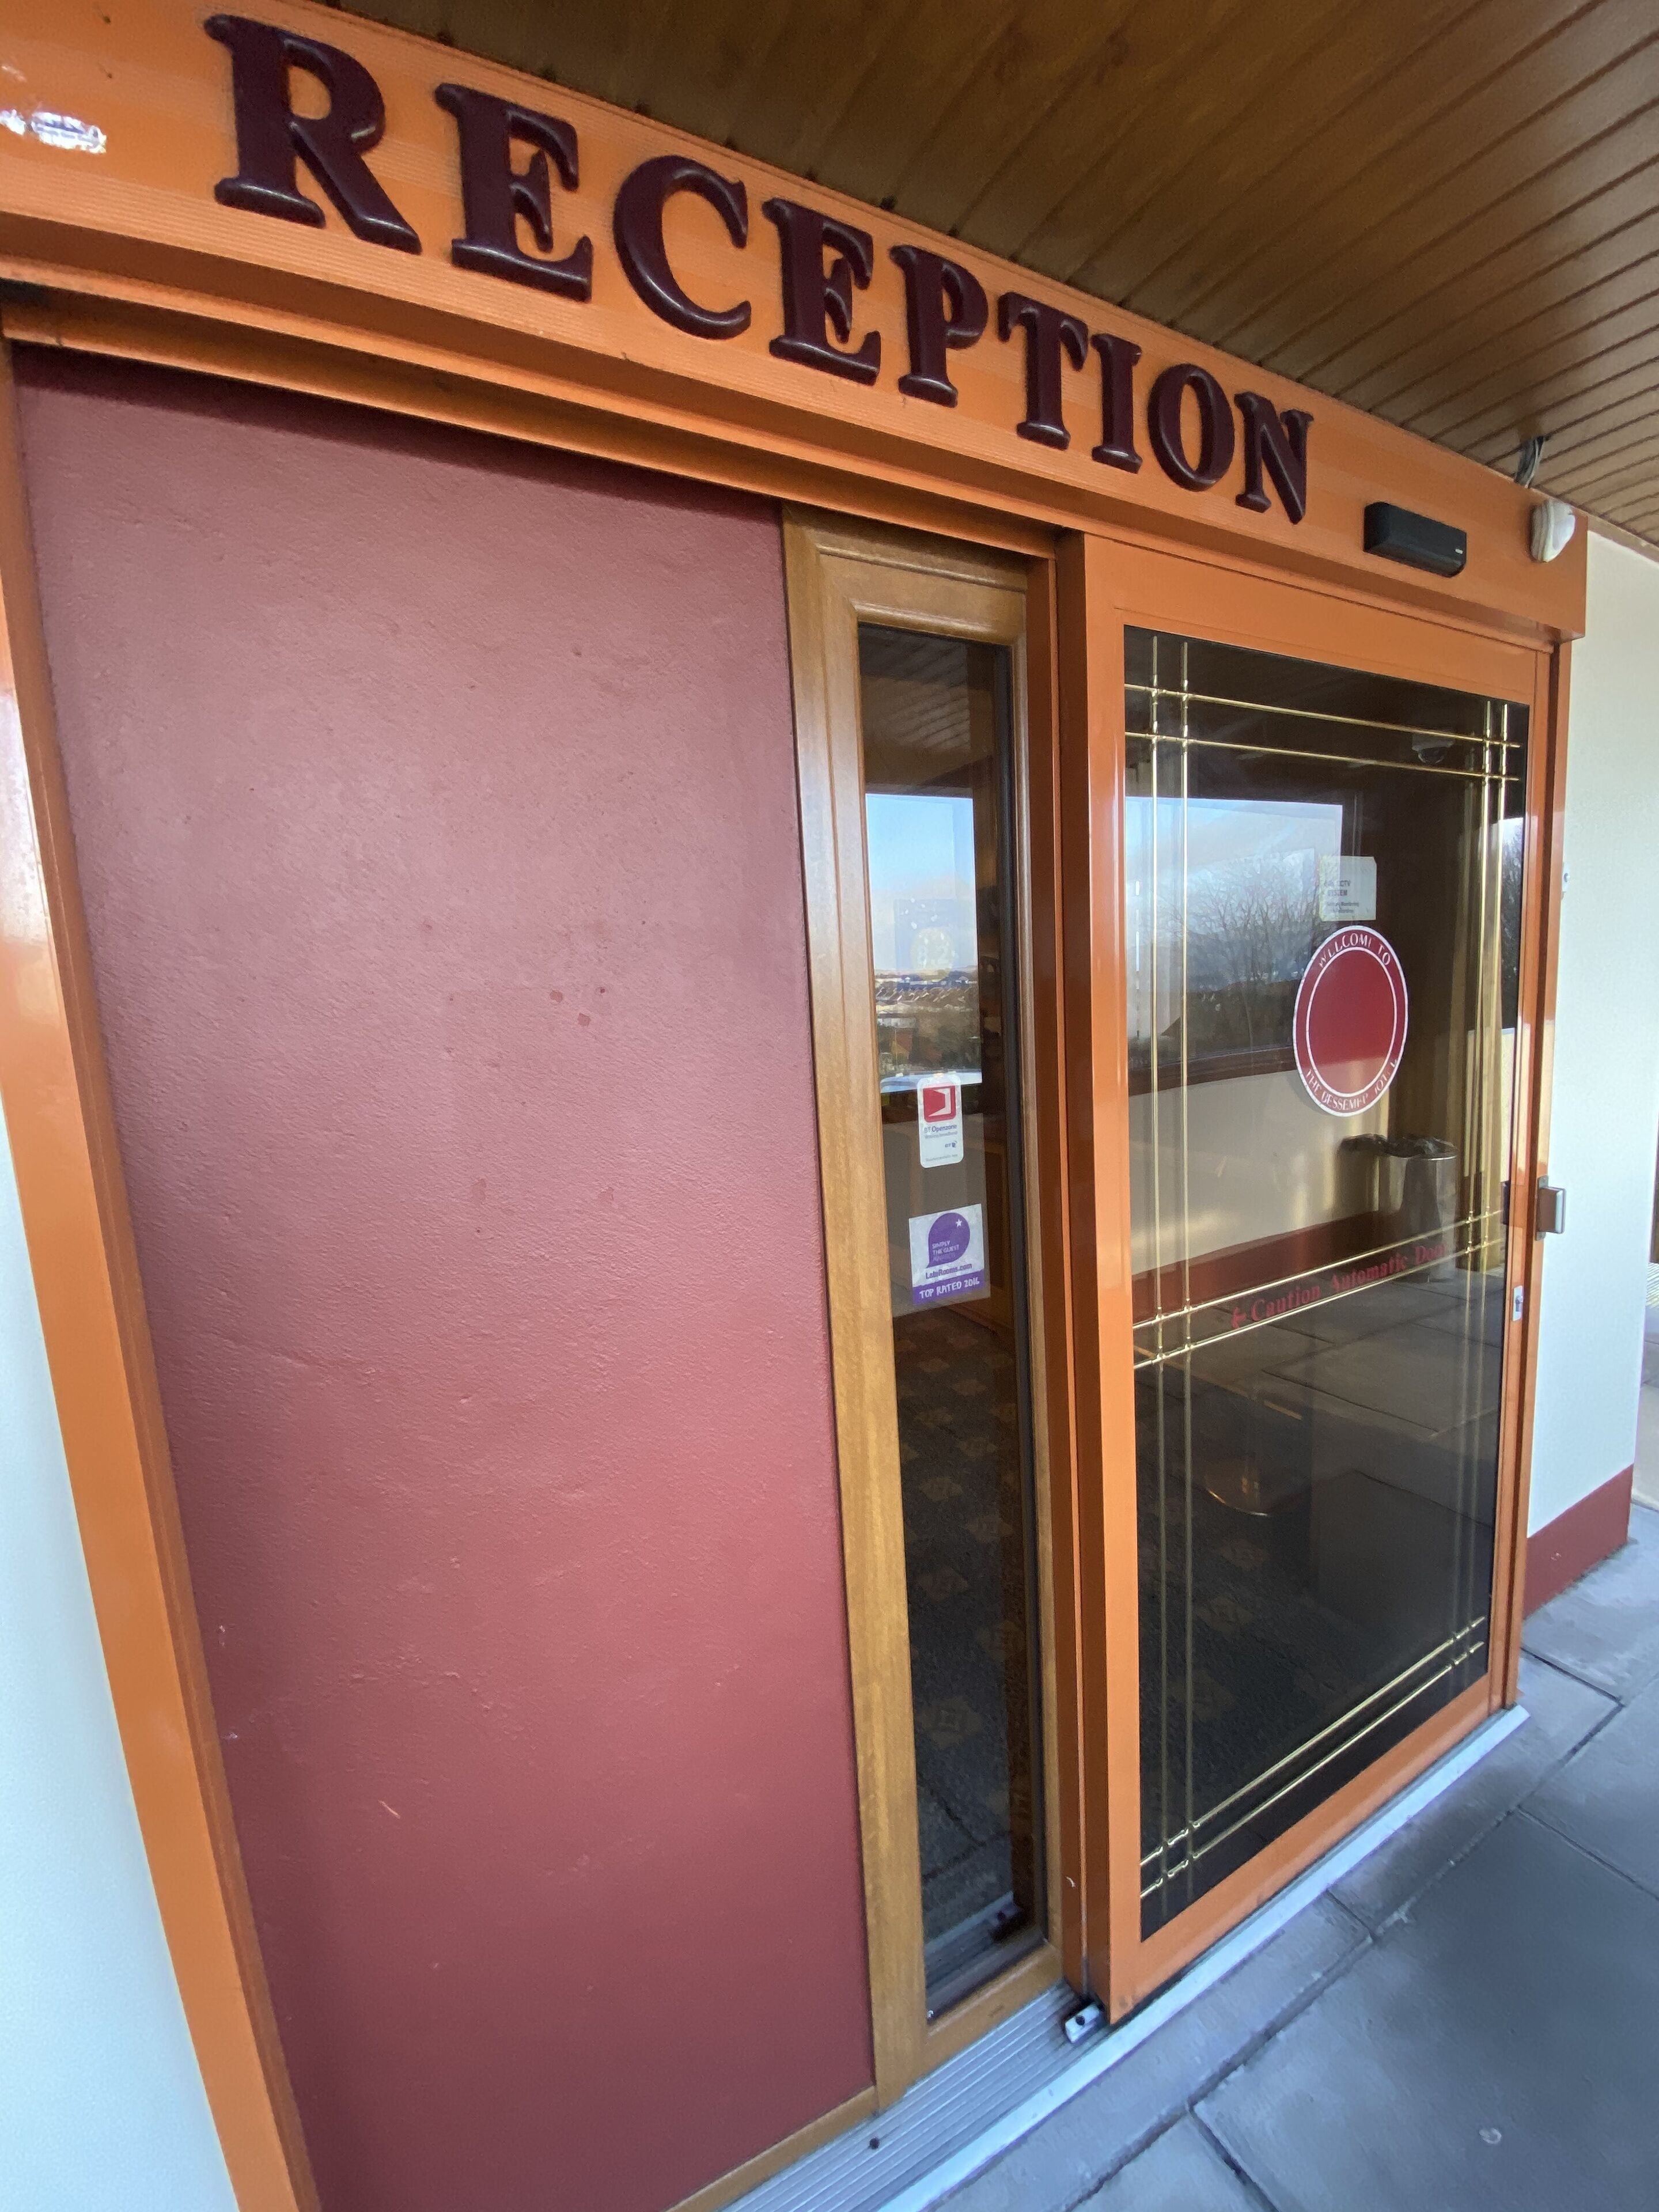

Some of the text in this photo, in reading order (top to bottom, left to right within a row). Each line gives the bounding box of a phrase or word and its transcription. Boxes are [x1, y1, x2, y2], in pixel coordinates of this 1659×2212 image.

[203, 14, 1314, 524] RECEPTION
[1377, 943, 1391, 966] TO
[1305, 1069, 1322, 1096] THE
[933, 1248, 943, 1256] THE
[925, 1263, 972, 1279] LateRooms.com
[919, 1277, 980, 1299] TOP RATED 2016
[1251, 1285, 1321, 1322] Caution
[1331, 1252, 1408, 1293] Automatic
